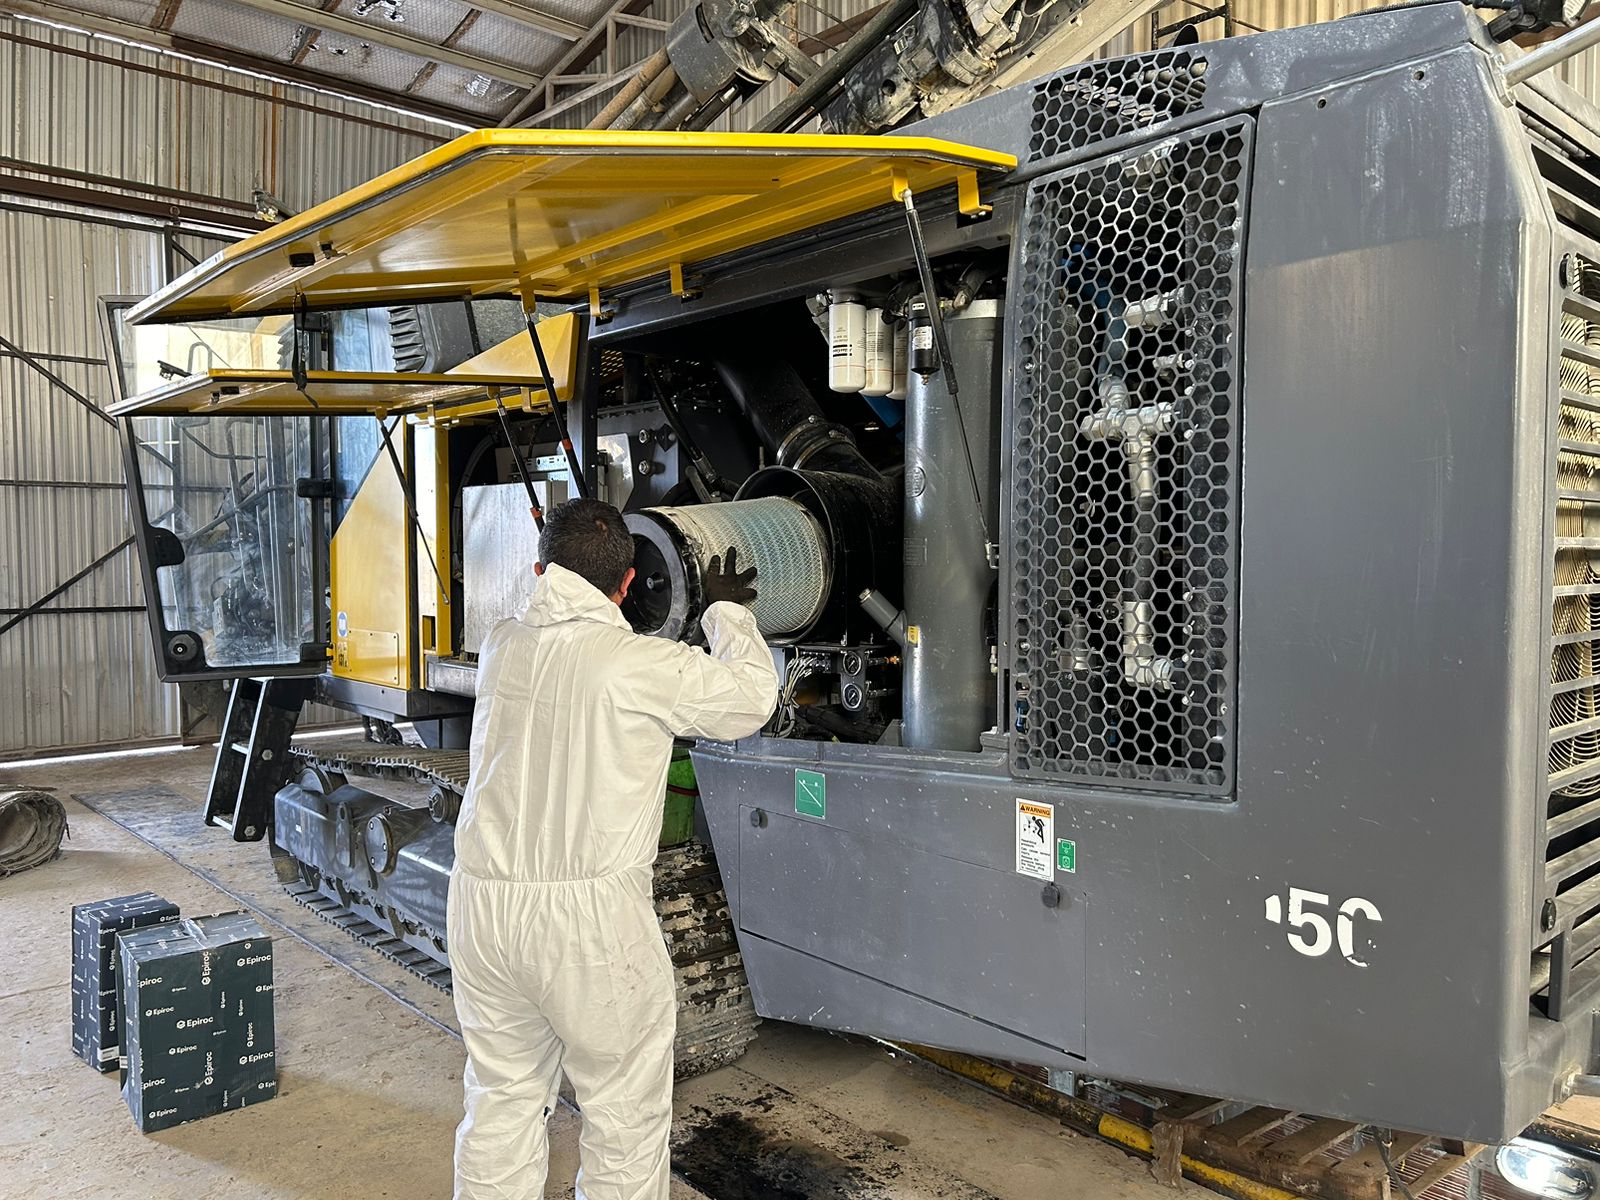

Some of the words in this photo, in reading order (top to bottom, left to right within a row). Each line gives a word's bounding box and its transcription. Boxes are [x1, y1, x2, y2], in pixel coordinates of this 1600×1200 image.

[1025, 806, 1050, 815] WARNING
[202, 951, 211, 976] Epiroc
[246, 955, 271, 965] Epiroc
[153, 1006, 174, 1015] Epiroc
[187, 1016, 214, 1028] Epiroc
[176, 1045, 197, 1054] Epiroc
[249, 1052, 273, 1063] Epiroc
[205, 1051, 213, 1076] Epiroc
[156, 1107, 177, 1117] Epiroc
